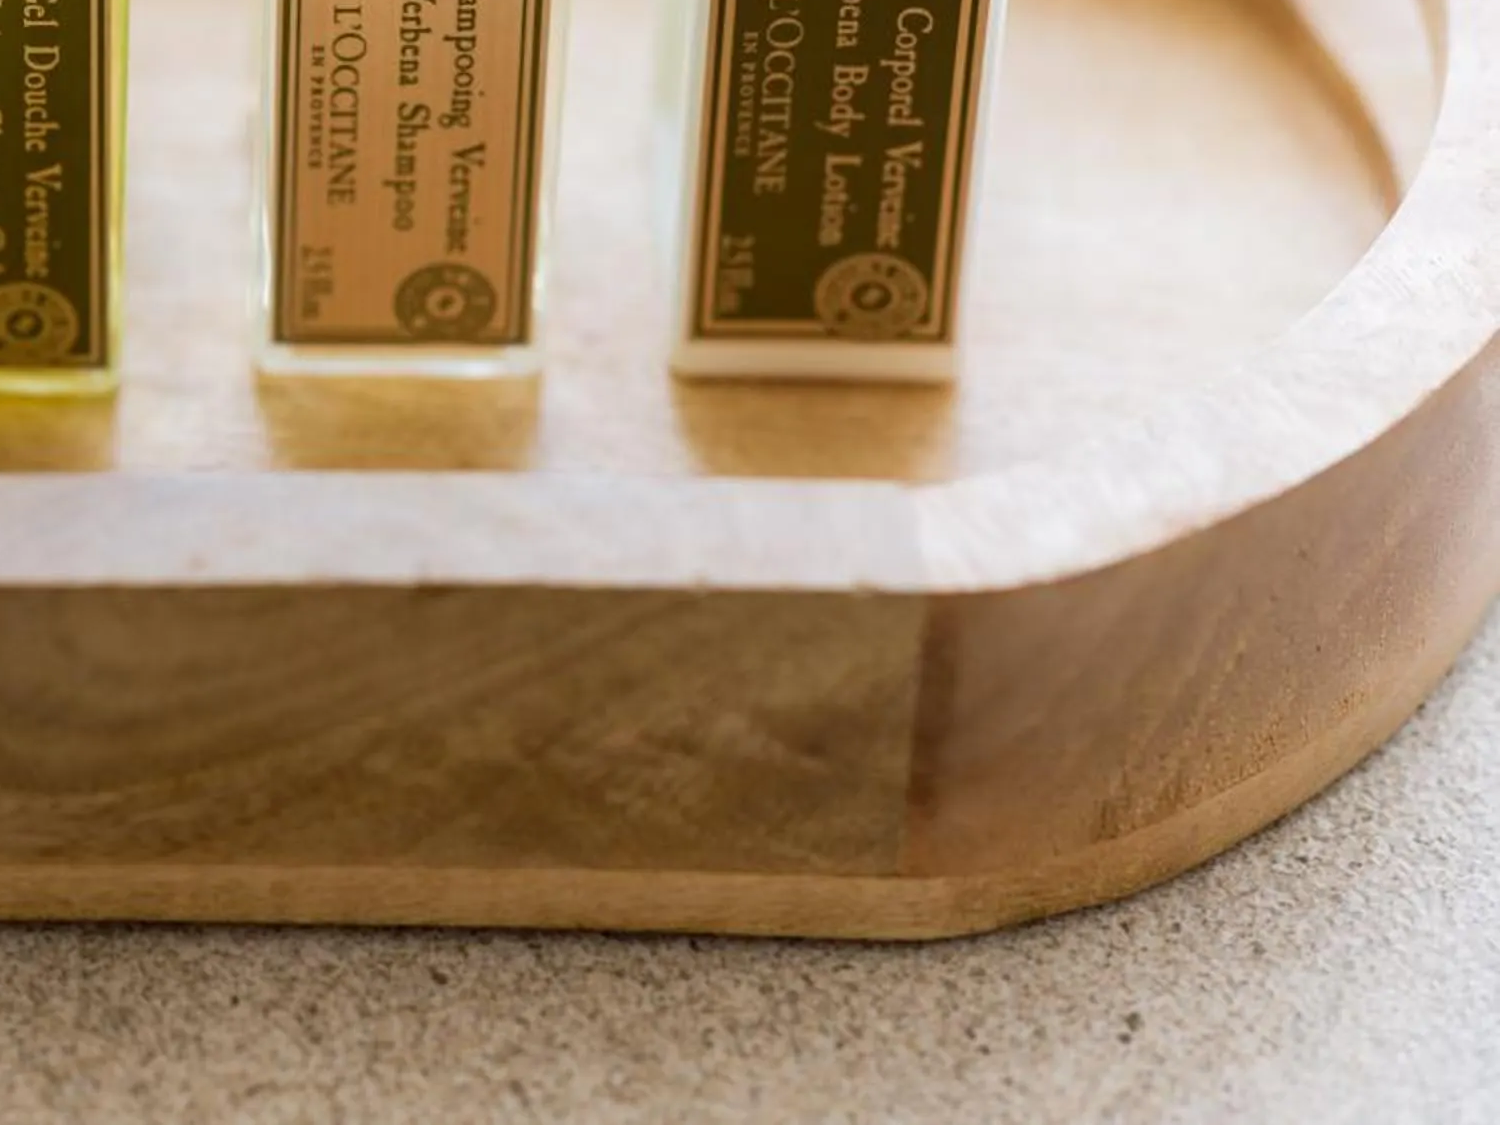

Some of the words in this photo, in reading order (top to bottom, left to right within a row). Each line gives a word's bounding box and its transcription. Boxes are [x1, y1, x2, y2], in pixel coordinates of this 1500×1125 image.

[311, 45, 324, 67] EN
[743, 32, 758, 53] EN
[880, 7, 934, 126] Corporel
[23, 46, 59, 151] Douche
[308, 77, 324, 169] PROVENCE
[327, 4, 367, 206] L'OCCITANE
[734, 63, 755, 158] PROVENCE
[815, 65, 869, 138] Body
[384, 102, 430, 232] Shampoo
[819, 154, 862, 246] Lotion
[24, 164, 61, 278] Verveine
